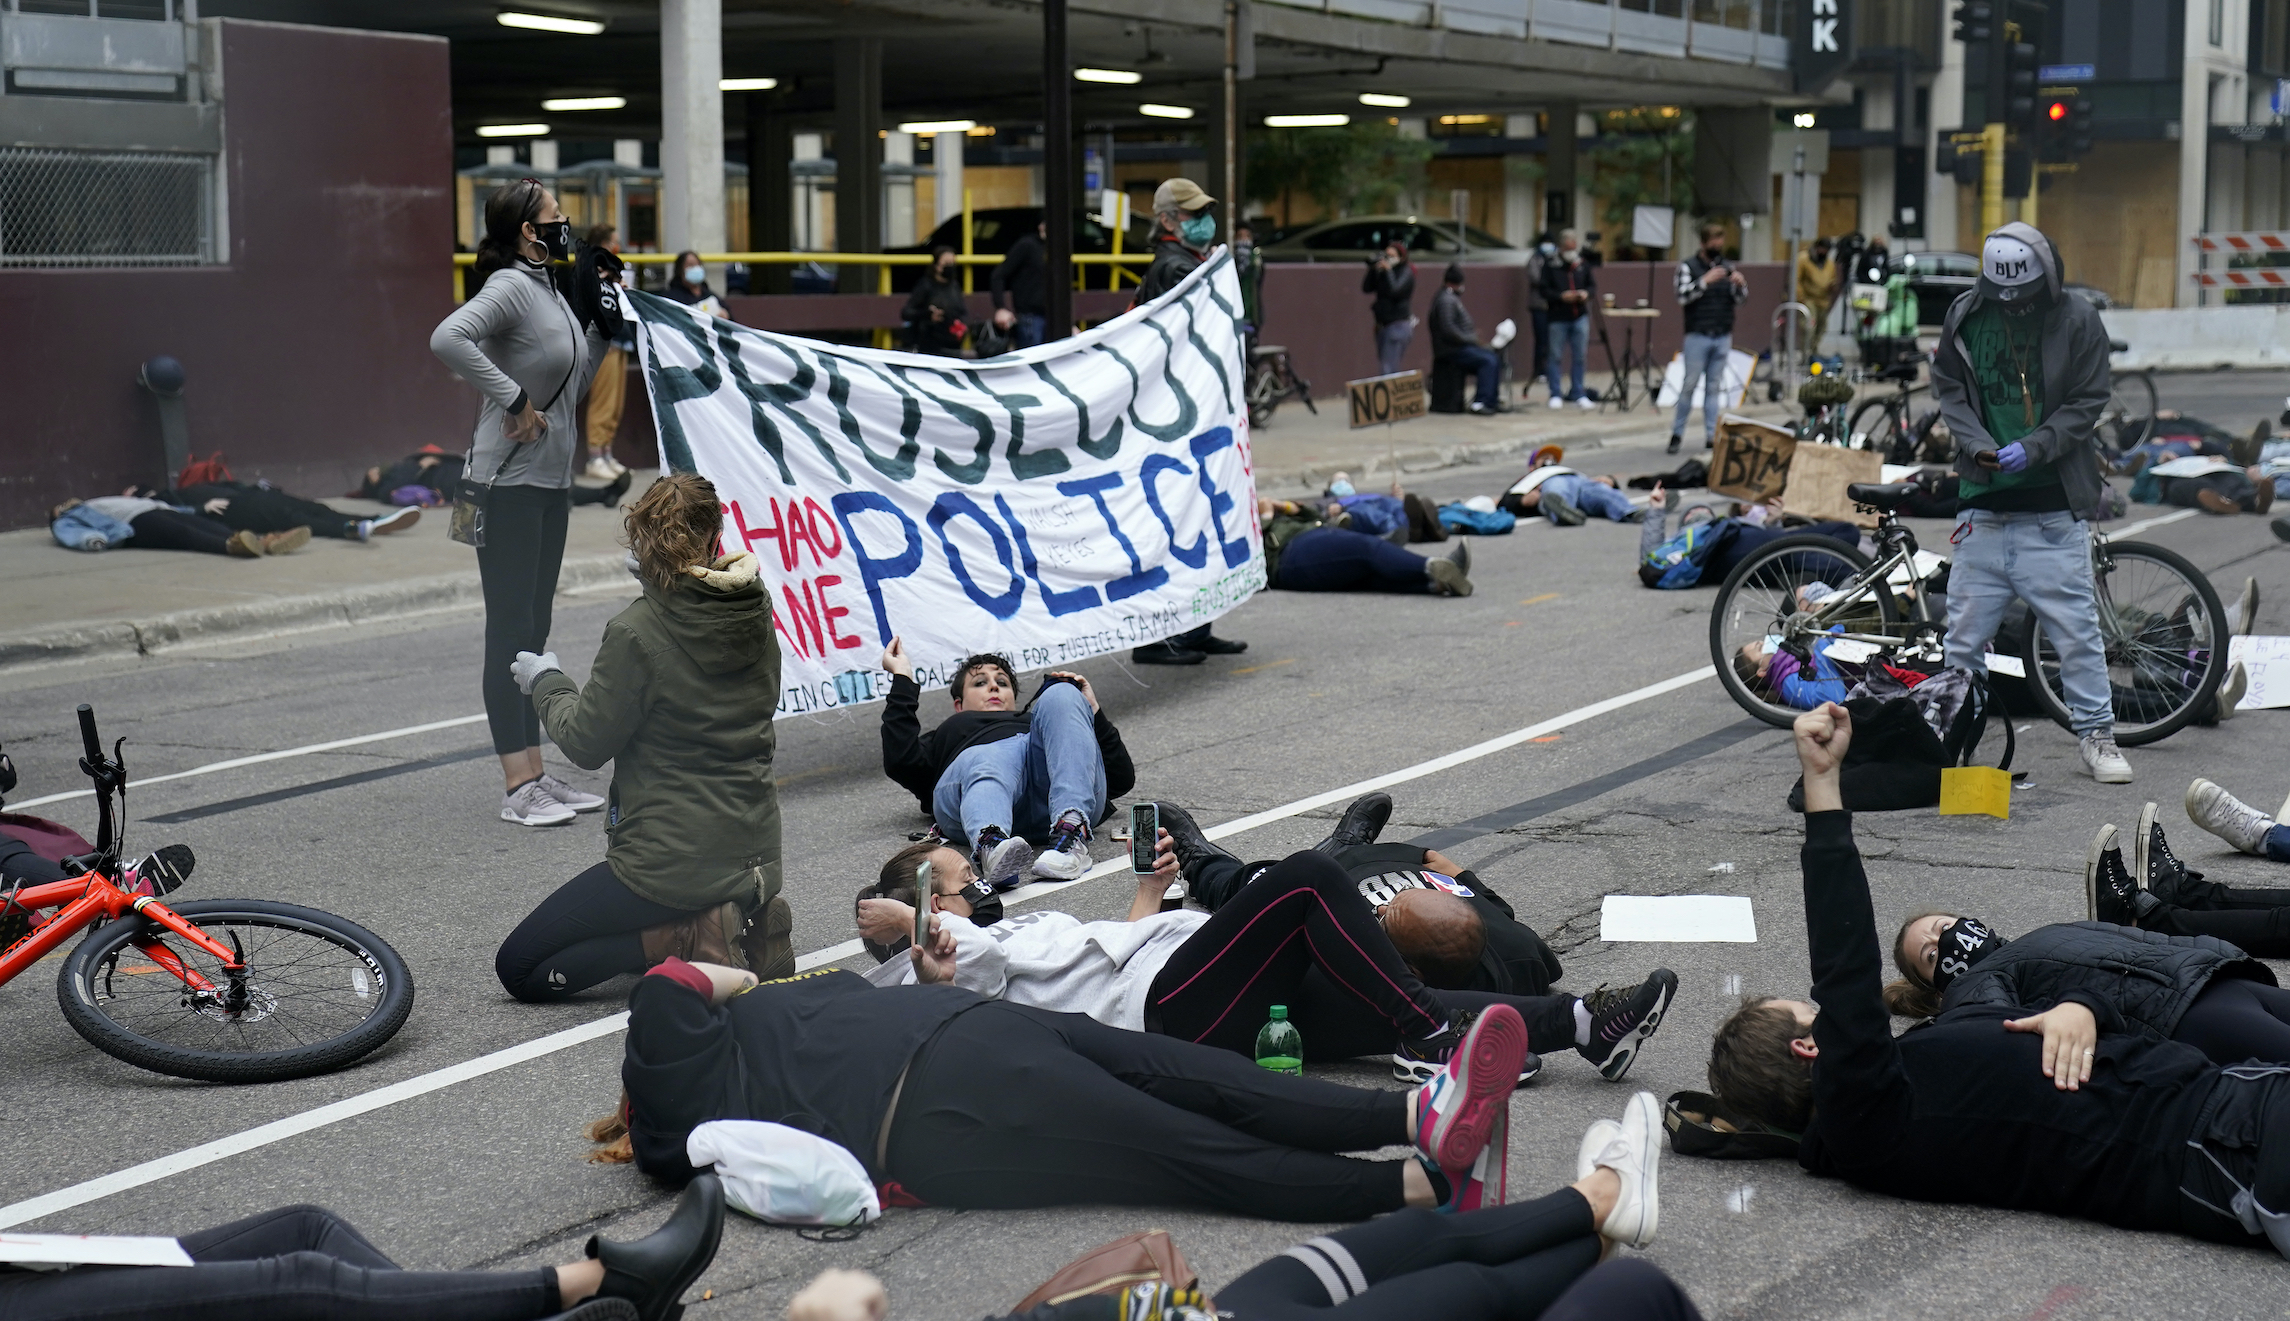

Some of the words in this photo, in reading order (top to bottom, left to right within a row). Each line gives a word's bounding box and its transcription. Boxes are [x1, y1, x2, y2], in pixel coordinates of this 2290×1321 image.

[1995, 259, 2028, 279] BLM
[1351, 381, 1391, 423] NO
[1720, 431, 1791, 493] BLM
[718, 496, 842, 572] HAO
[831, 426, 1251, 649] POLICE
[1020, 503, 1078, 530] WALSH
[1042, 537, 1095, 569] KEYES
[772, 575, 861, 662] ANE
[1023, 648, 1051, 669] FOR
[1058, 631, 1114, 661] JUSTICE
[1123, 601, 1182, 642] JAMAR
[1940, 920, 1989, 978] 8:46
